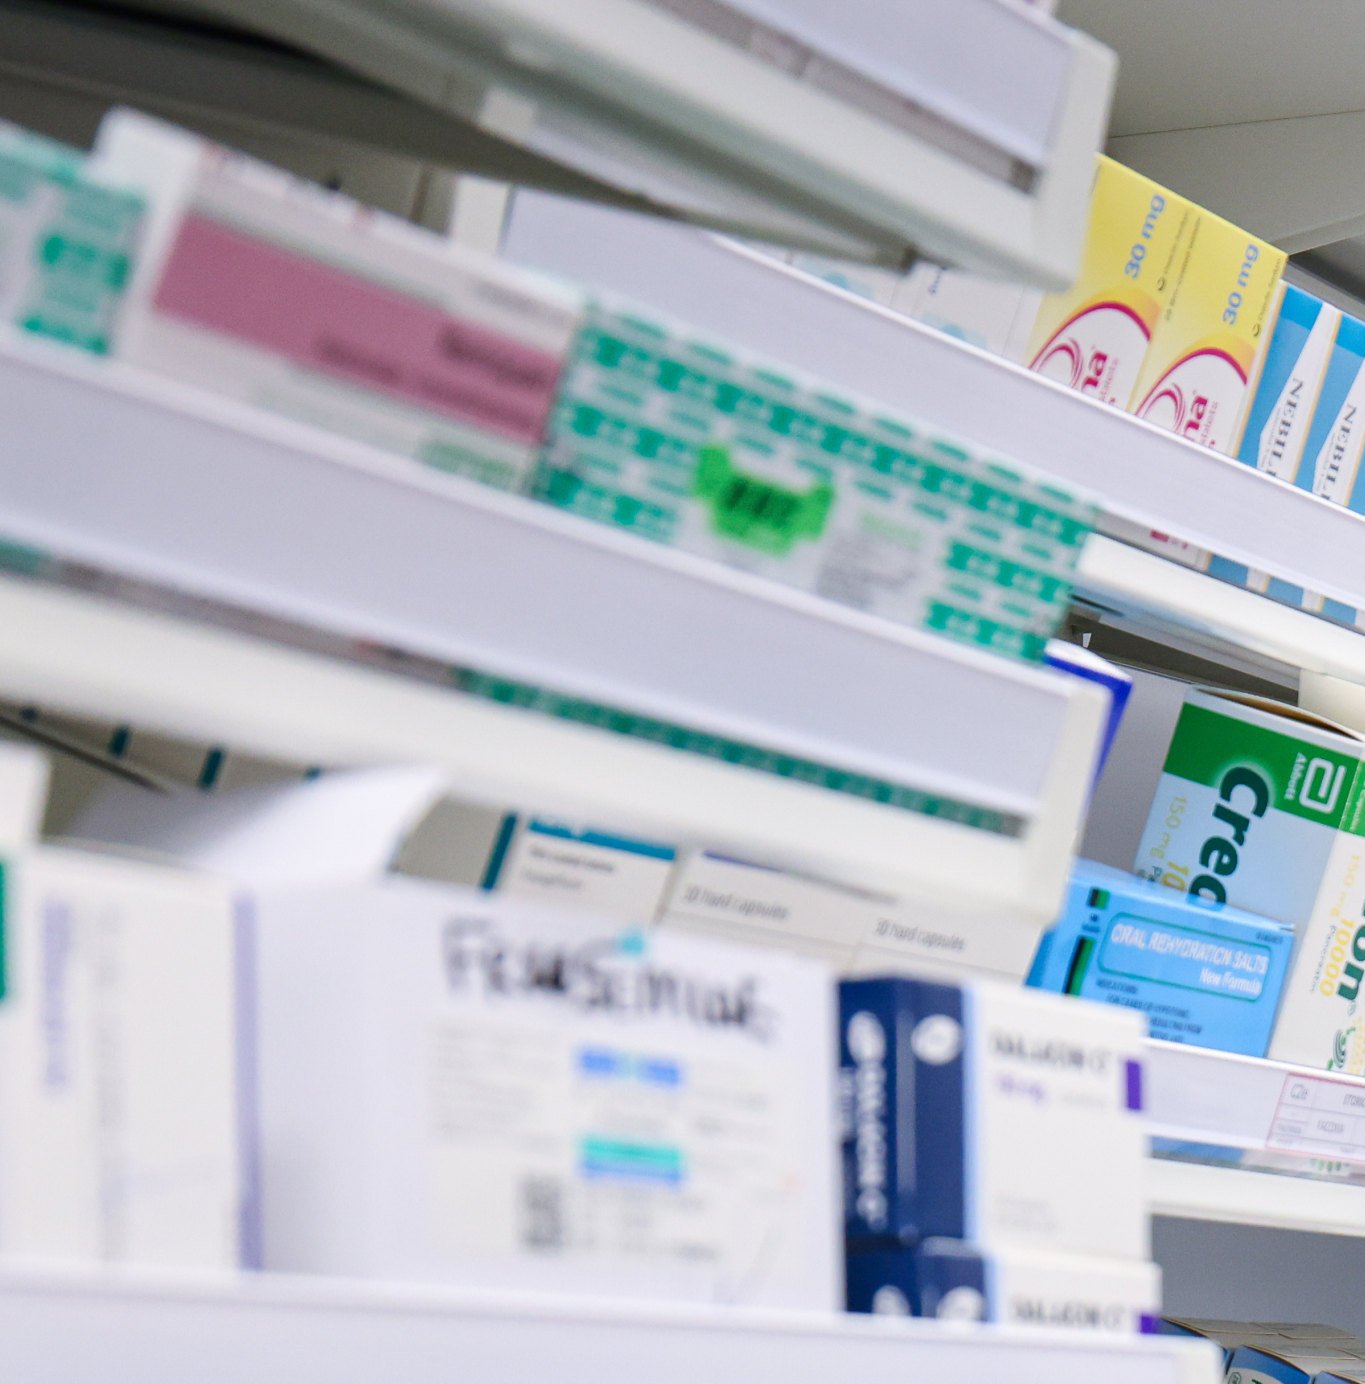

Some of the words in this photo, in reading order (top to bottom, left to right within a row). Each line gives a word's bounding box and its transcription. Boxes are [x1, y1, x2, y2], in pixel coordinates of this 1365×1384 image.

[1125, 243, 1146, 280] 30
[1141, 194, 1165, 240] mg
[1223, 292, 1242, 325] 30
[1237, 244, 1260, 287] mg
[1164, 796, 1187, 829] 150
[1111, 922, 1147, 949] ORAL
[1148, 931, 1232, 964] REHYDRATION
[1232, 948, 1268, 974] SALTS
[1200, 968, 1221, 985] New
[1222, 972, 1262, 994] Formula
[1318, 917, 1356, 997] 10000
